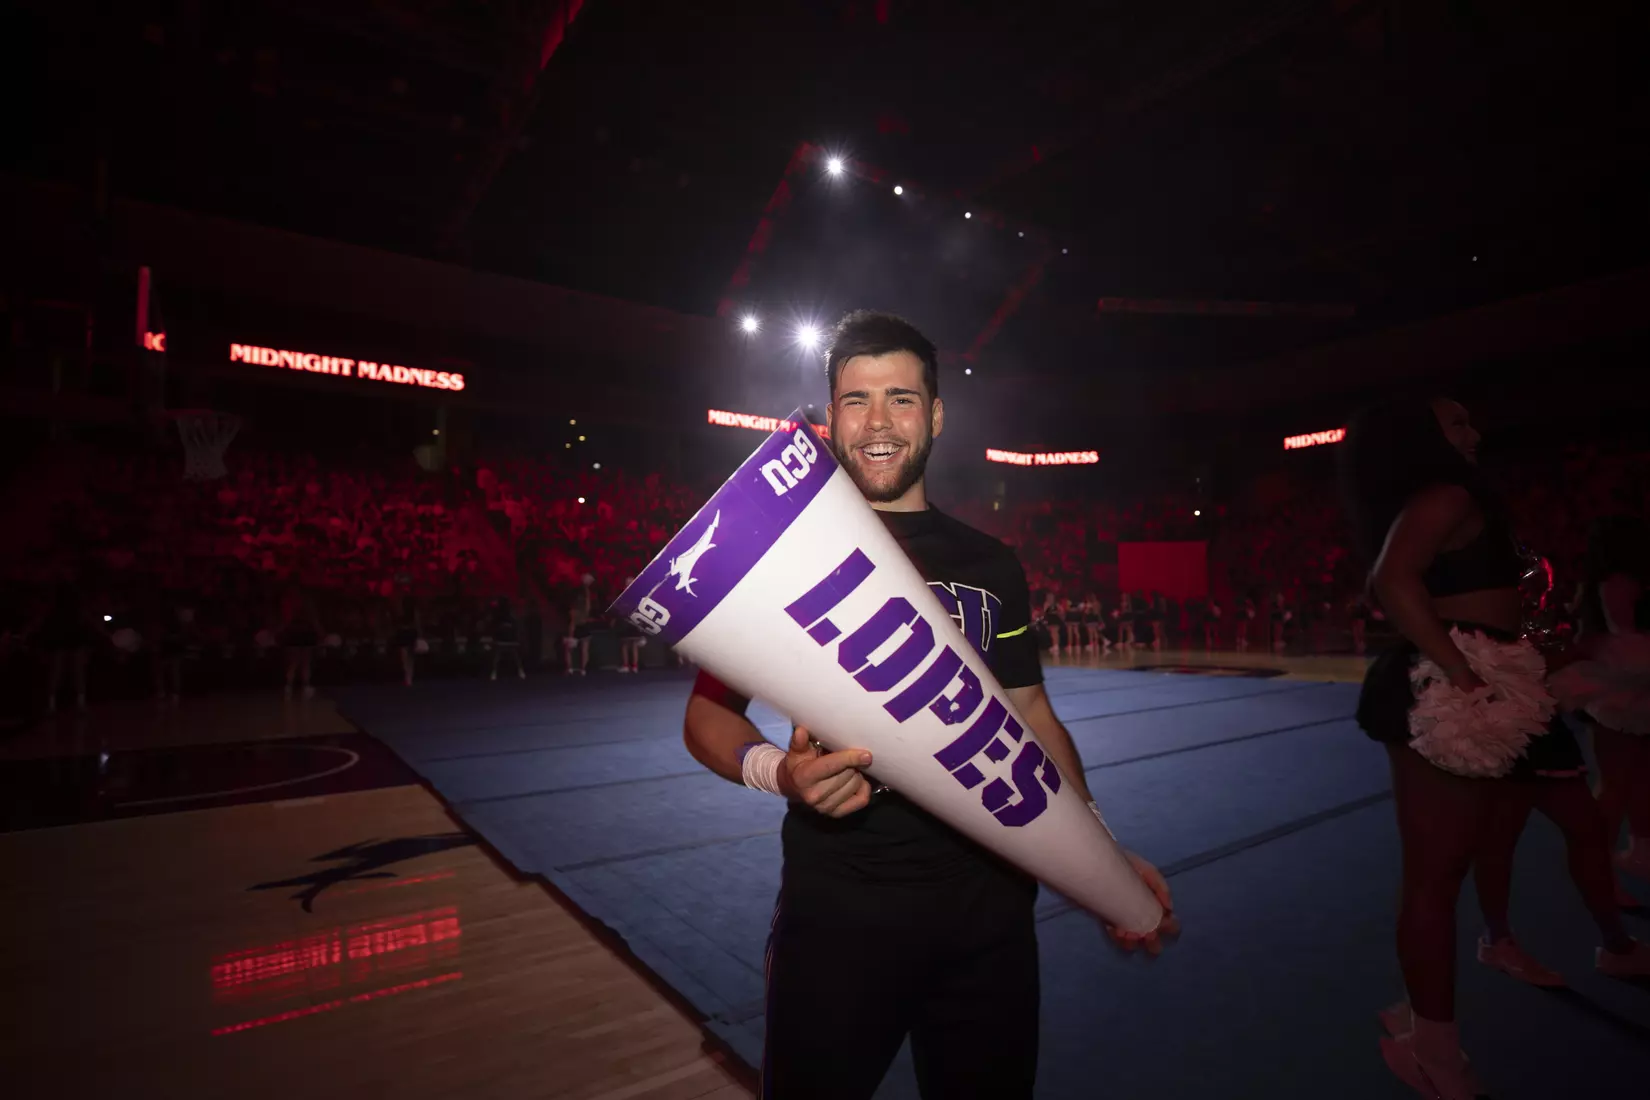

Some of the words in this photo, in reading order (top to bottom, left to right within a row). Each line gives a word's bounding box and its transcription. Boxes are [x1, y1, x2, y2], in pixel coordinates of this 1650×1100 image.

[230, 343, 354, 376] MIDNIGHT
[358, 361, 464, 391] MADNESS
[707, 409, 778, 432] MIDNIGHT
[760, 428, 818, 496] GCU
[1034, 451, 1099, 465] MADNESS
[628, 596, 671, 636] GC
[784, 547, 1061, 828] LOPES
